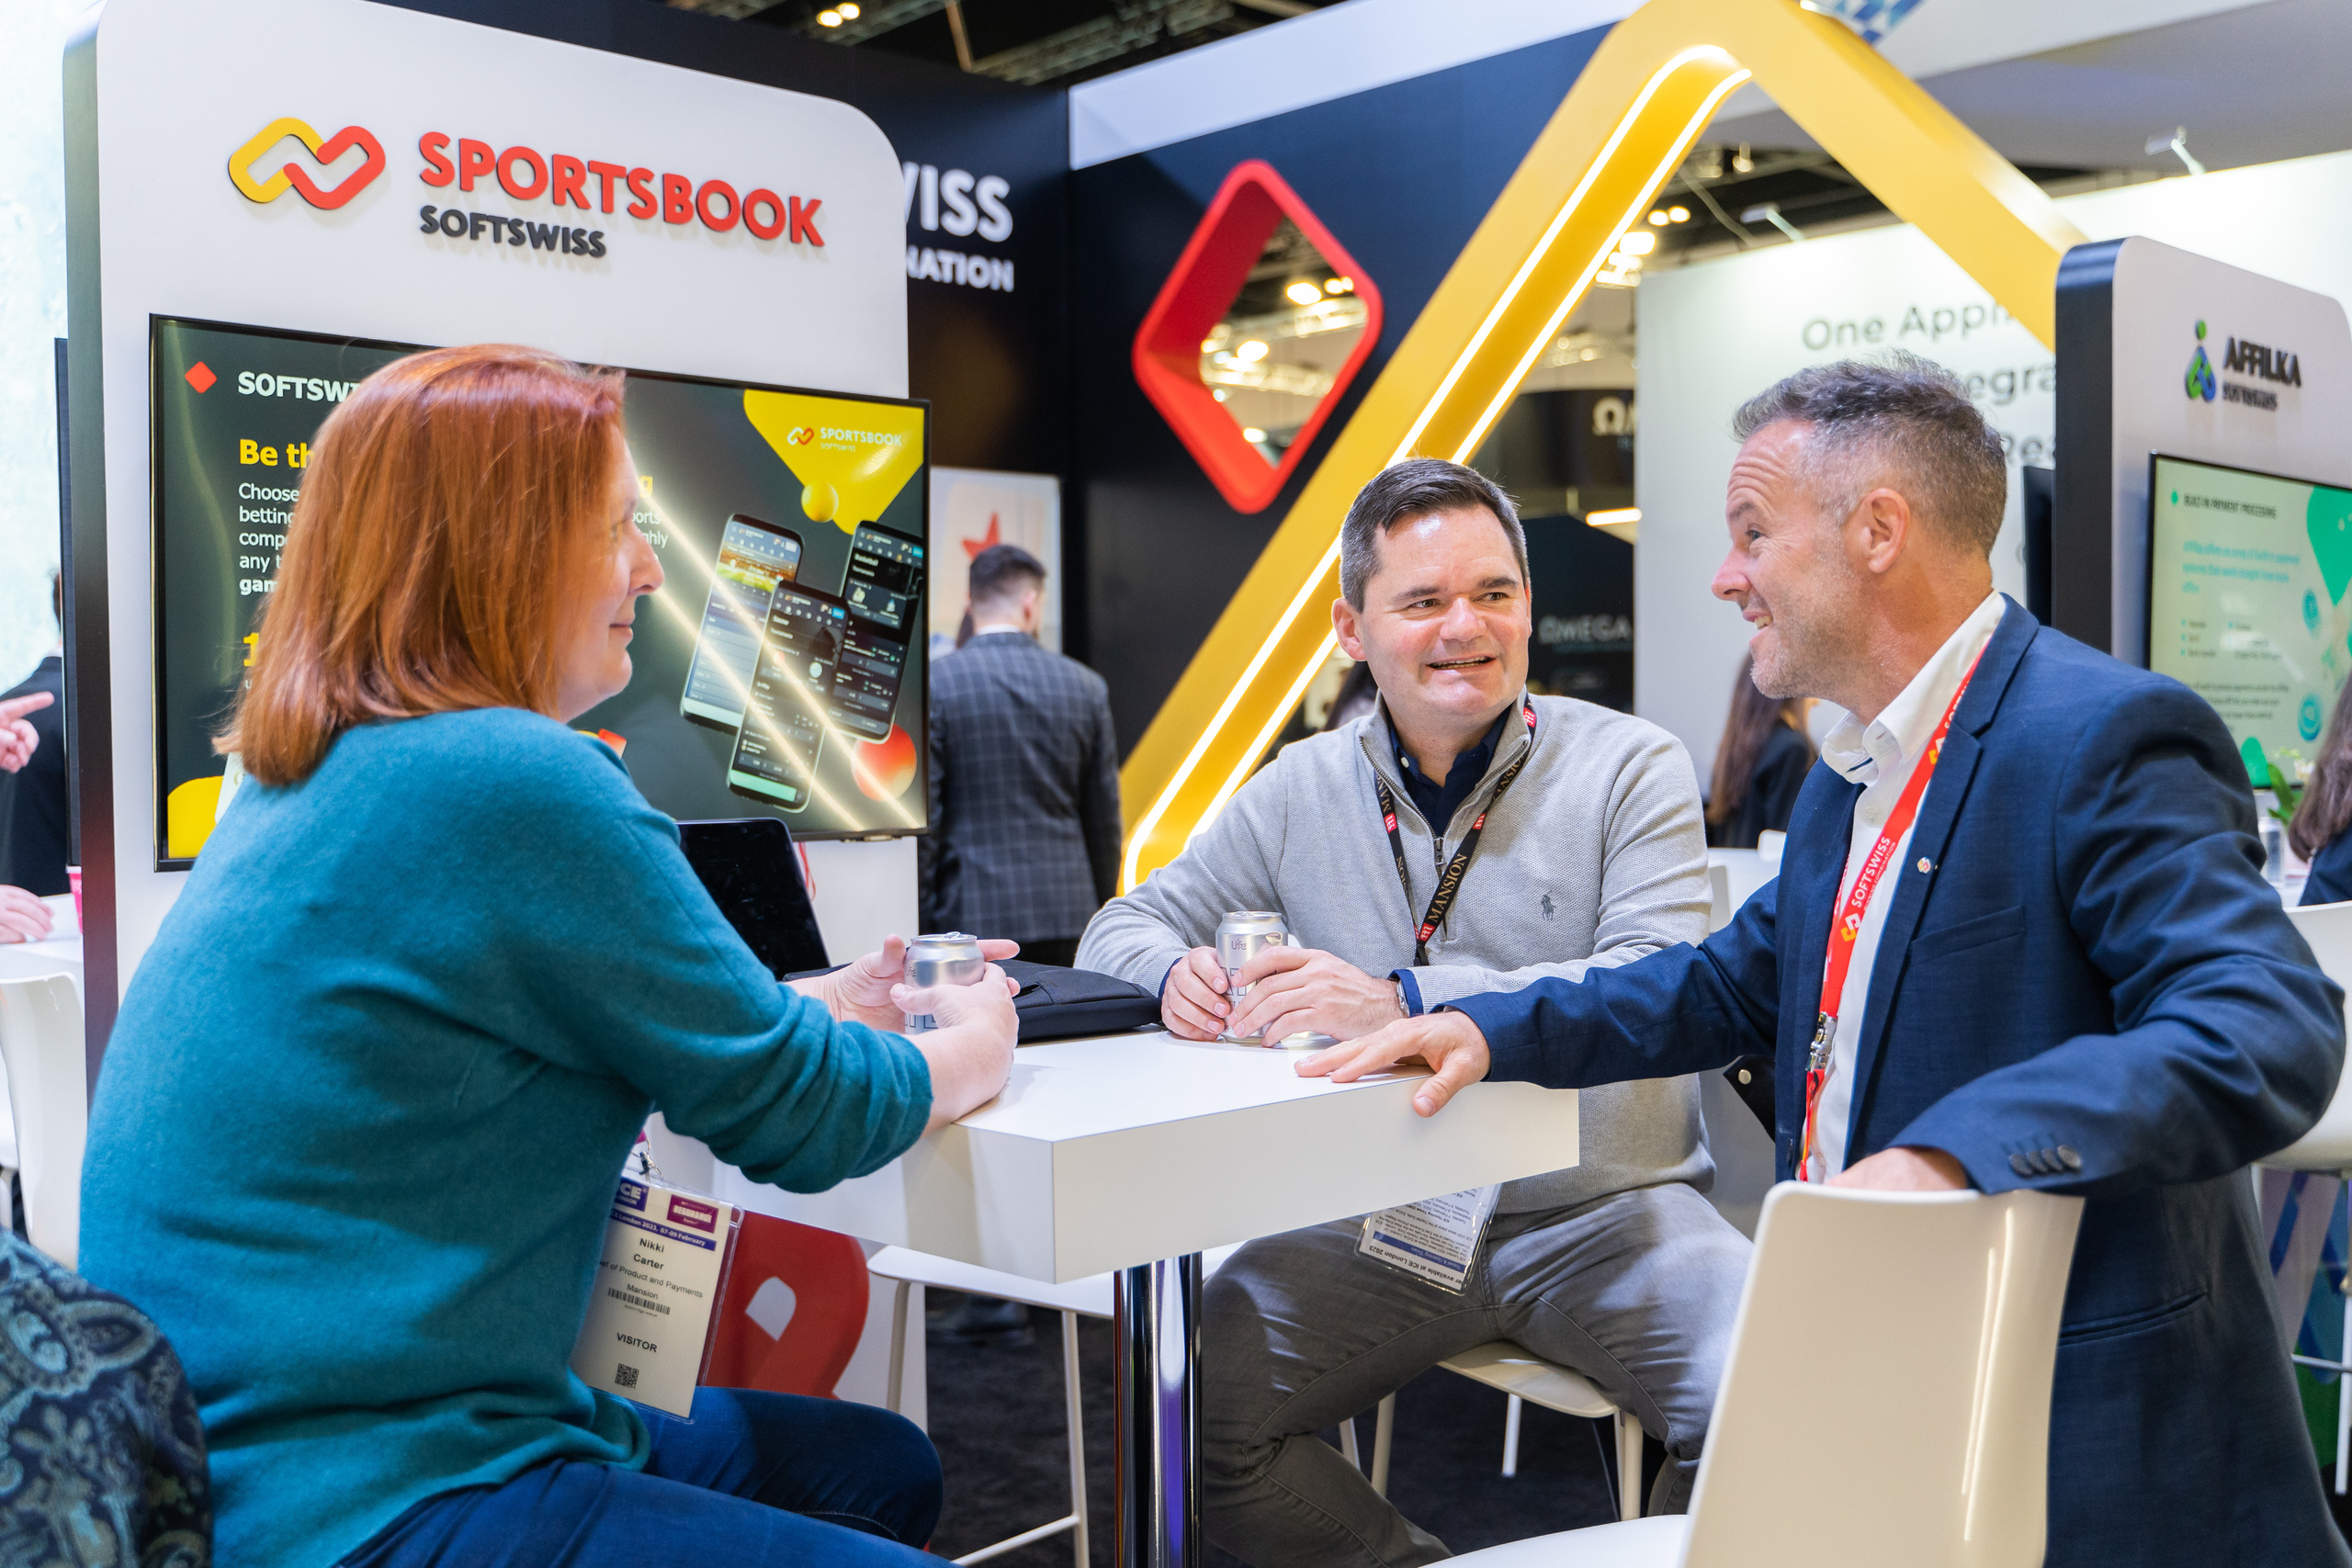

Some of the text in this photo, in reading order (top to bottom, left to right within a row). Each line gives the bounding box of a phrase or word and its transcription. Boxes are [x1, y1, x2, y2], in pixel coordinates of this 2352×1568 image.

[419, 131, 825, 247] SPORTSBOOK
[420, 205, 606, 257] SOFTSWISS
[1802, 318, 1884, 351] One
[2222, 336, 2301, 388] AFFILKA
[820, 426, 902, 446] SPORTSBOOK
[239, 439, 278, 466] Be
[238, 482, 300, 502] Choose
[239, 556, 270, 573] any
[1851, 837, 1890, 908] SOFTSWISS
[1428, 853, 1468, 923] MANSION
[618, 1214, 641, 1225] London
[641, 1222, 658, 1232] 2023,
[660, 1227, 677, 1237] 07-09
[677, 1233, 705, 1247] February
[639, 1237, 664, 1252] Nikki
[1369, 1245, 1383, 1255] 2023
[633, 1253, 664, 1269] Carter
[1384, 1251, 1407, 1264] London
[1408, 1260, 1419, 1269] ICE
[1424, 1252, 1442, 1262] Opening
[1447, 1260, 1460, 1269] Travel
[610, 1262, 617, 1270] of
[619, 1266, 648, 1280] Product
[650, 1276, 663, 1285] and
[665, 1280, 703, 1298] Payments
[1427, 1268, 1453, 1282] available
[627, 1283, 658, 1299] Mansion
[616, 1332, 657, 1352] VISITOR
